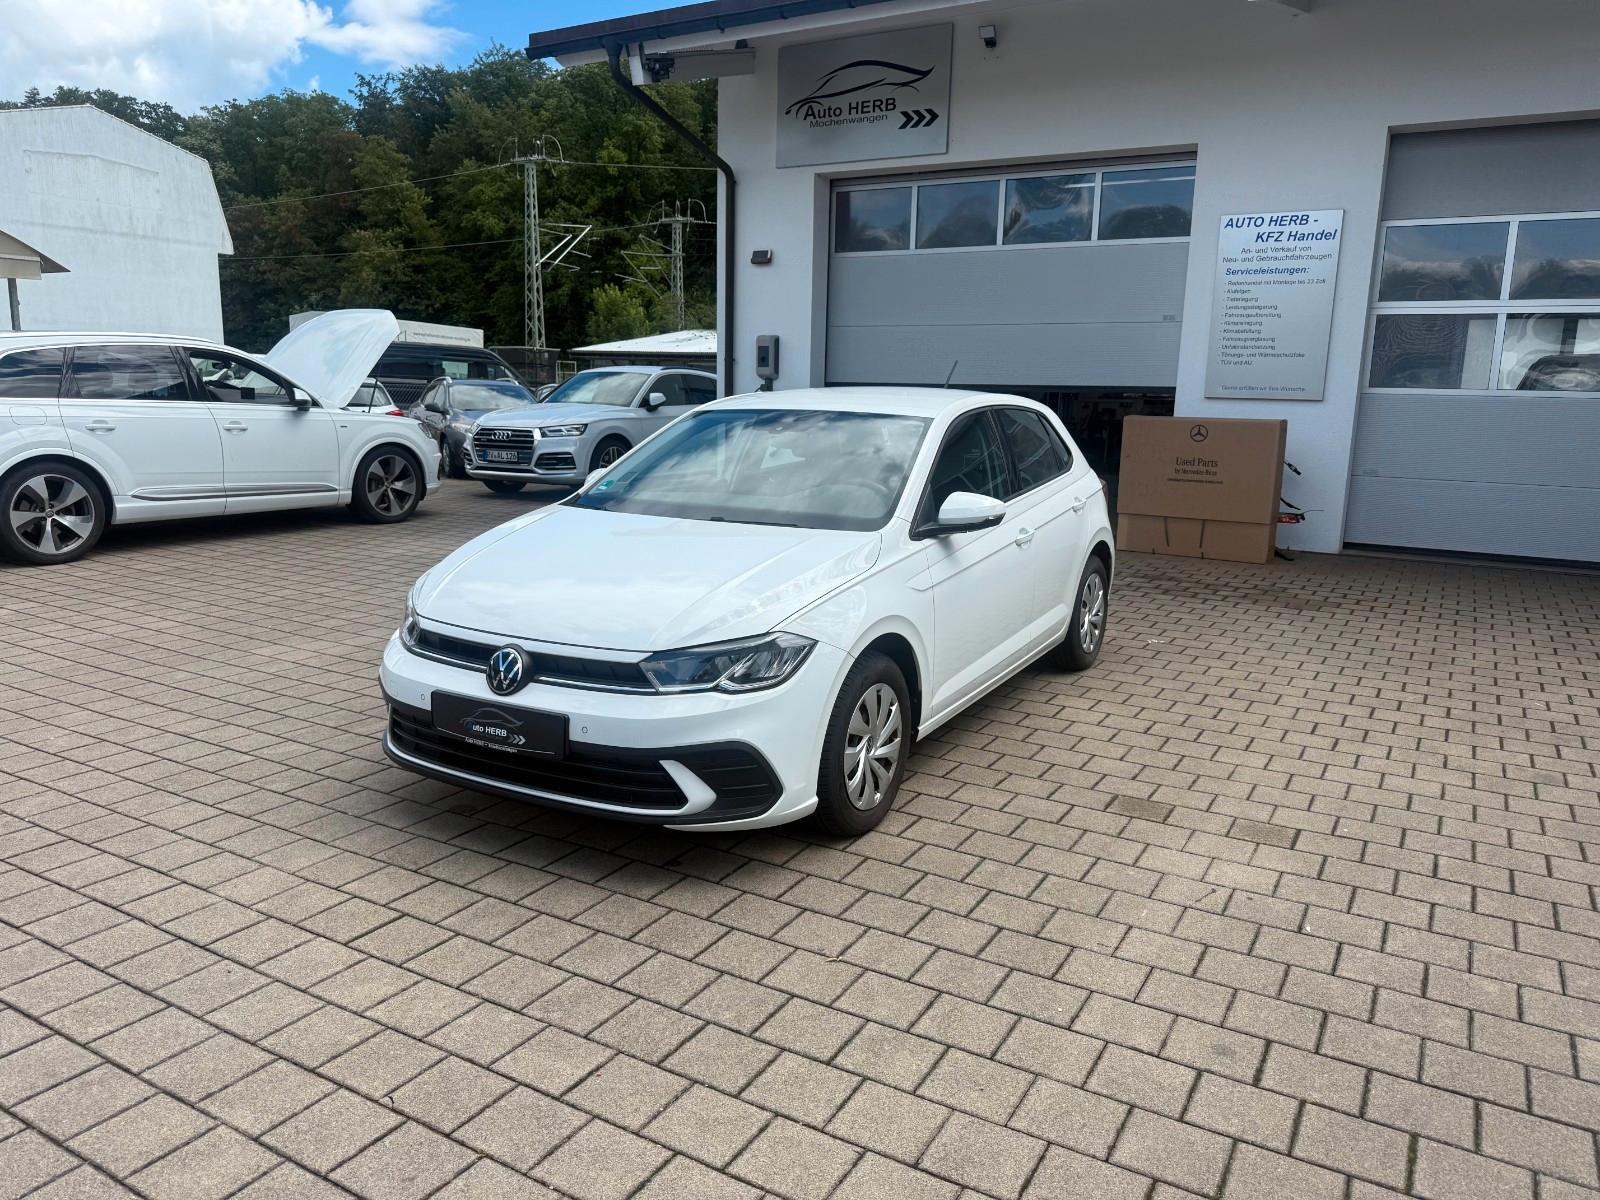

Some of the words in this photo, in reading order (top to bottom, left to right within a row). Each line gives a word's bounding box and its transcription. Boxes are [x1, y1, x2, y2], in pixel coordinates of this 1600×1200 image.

[803, 105, 843, 120] Auto
[848, 98, 897, 115] HERB
[809, 114, 888, 129] Mochenwangen
[1224, 216, 1265, 229] AUTO
[1268, 214, 1310, 227] HERB
[1255, 231, 1284, 243] KFZ
[1287, 229, 1338, 242] Handel
[1271, 245, 1297, 253] Verkauf
[1256, 253, 1332, 262] Gebrauchtfahrzeugen
[1225, 266, 1310, 276] Serviceleistungen:
[1176, 457, 1196, 467] Used
[1197, 457, 1219, 468] Parts
[485, 726, 507, 737] HERB
